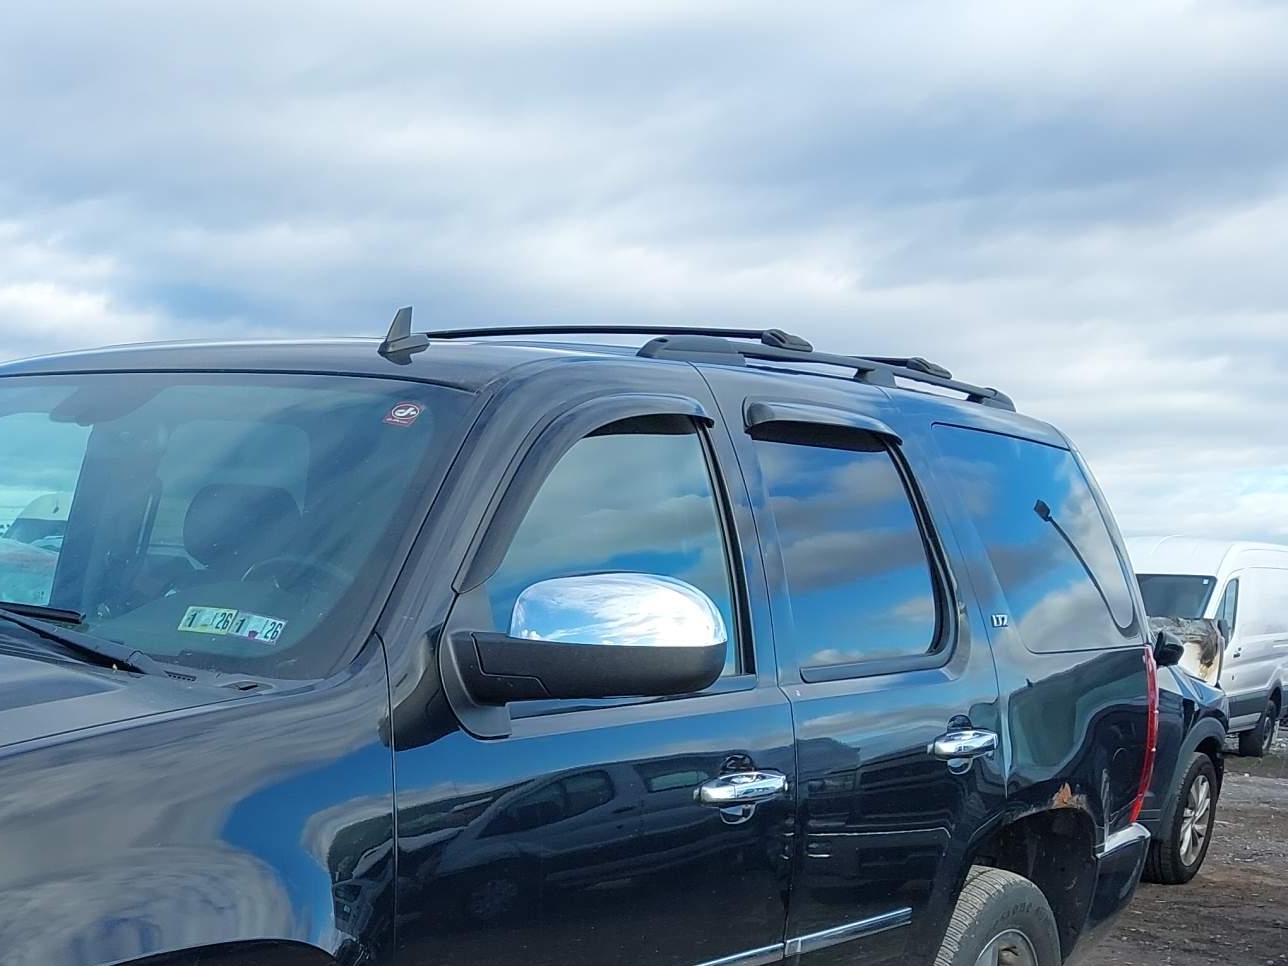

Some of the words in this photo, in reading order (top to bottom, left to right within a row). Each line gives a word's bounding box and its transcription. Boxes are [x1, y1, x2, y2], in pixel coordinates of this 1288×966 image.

[215, 612, 232, 630] 26
[991, 614, 1009, 627] LTZ
[264, 621, 282, 640] 26
